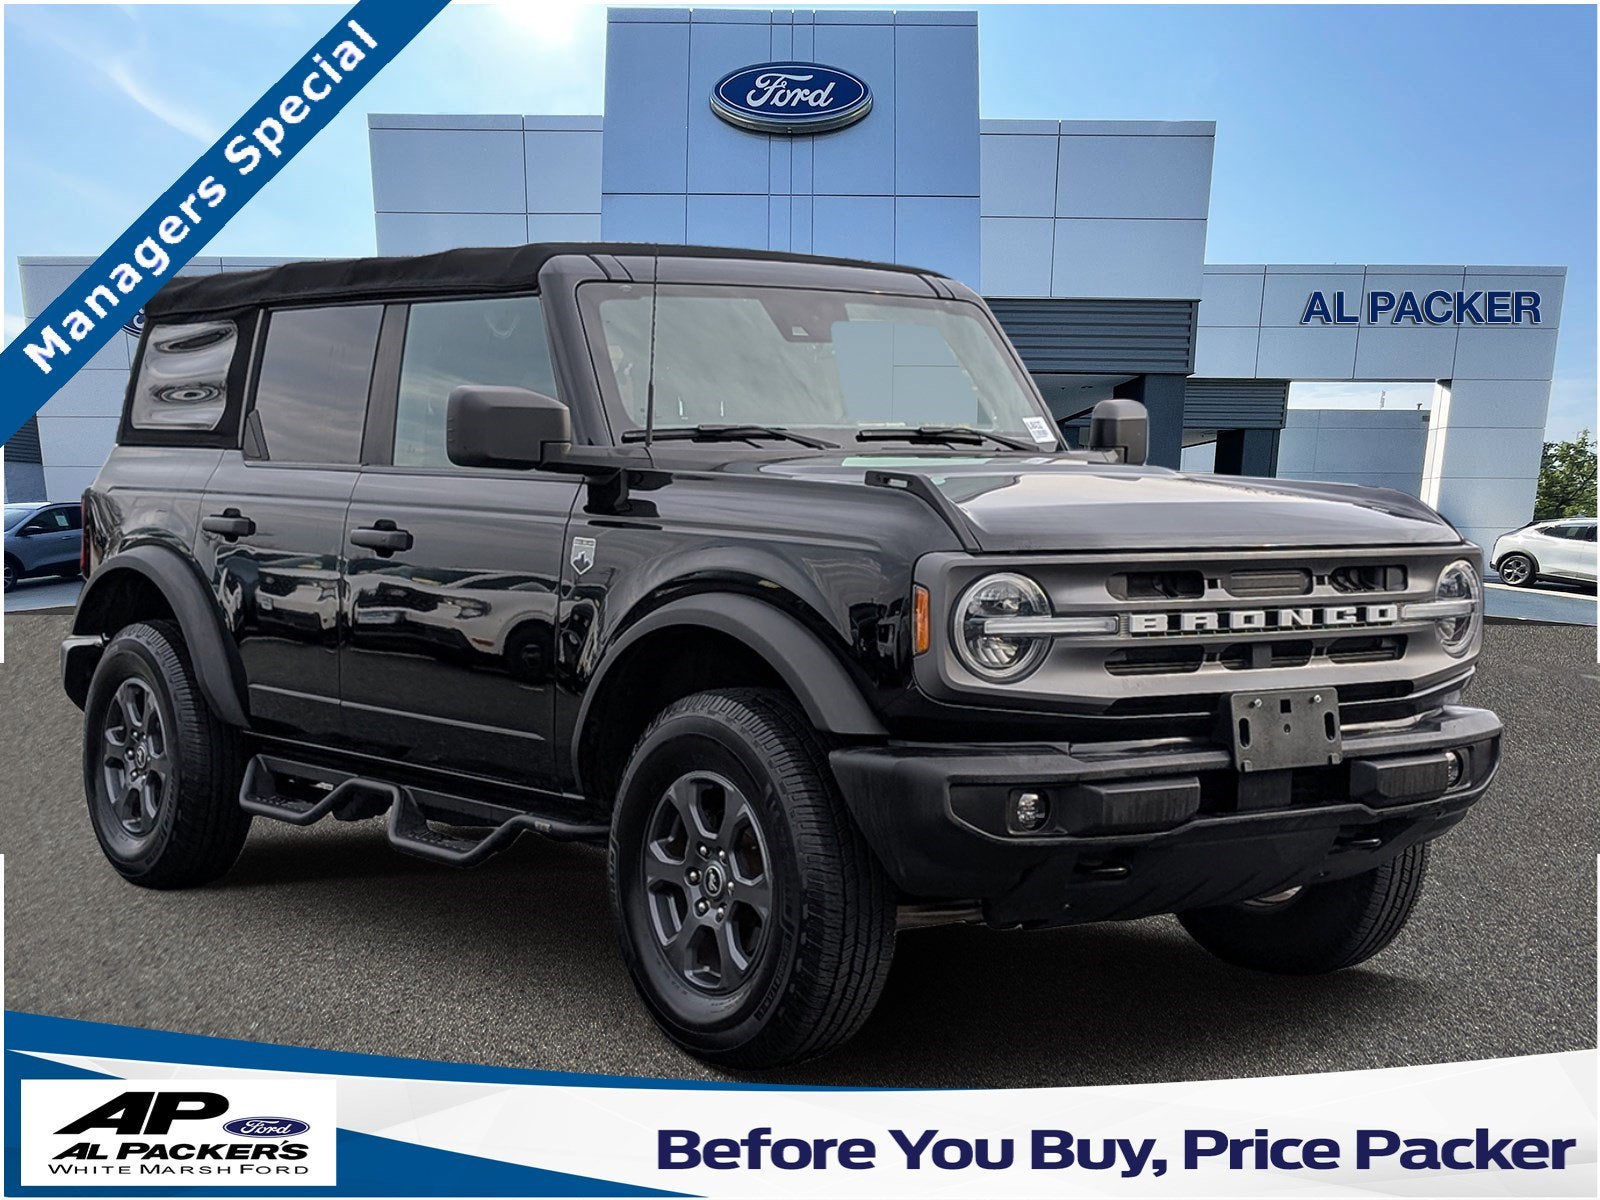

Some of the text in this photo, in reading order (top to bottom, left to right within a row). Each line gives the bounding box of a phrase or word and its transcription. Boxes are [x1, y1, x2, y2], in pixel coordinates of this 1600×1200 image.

[746, 73, 836, 107] Ford
[1302, 290, 1541, 324] AL PACKER
[1129, 604, 1398, 632] BRONCO
